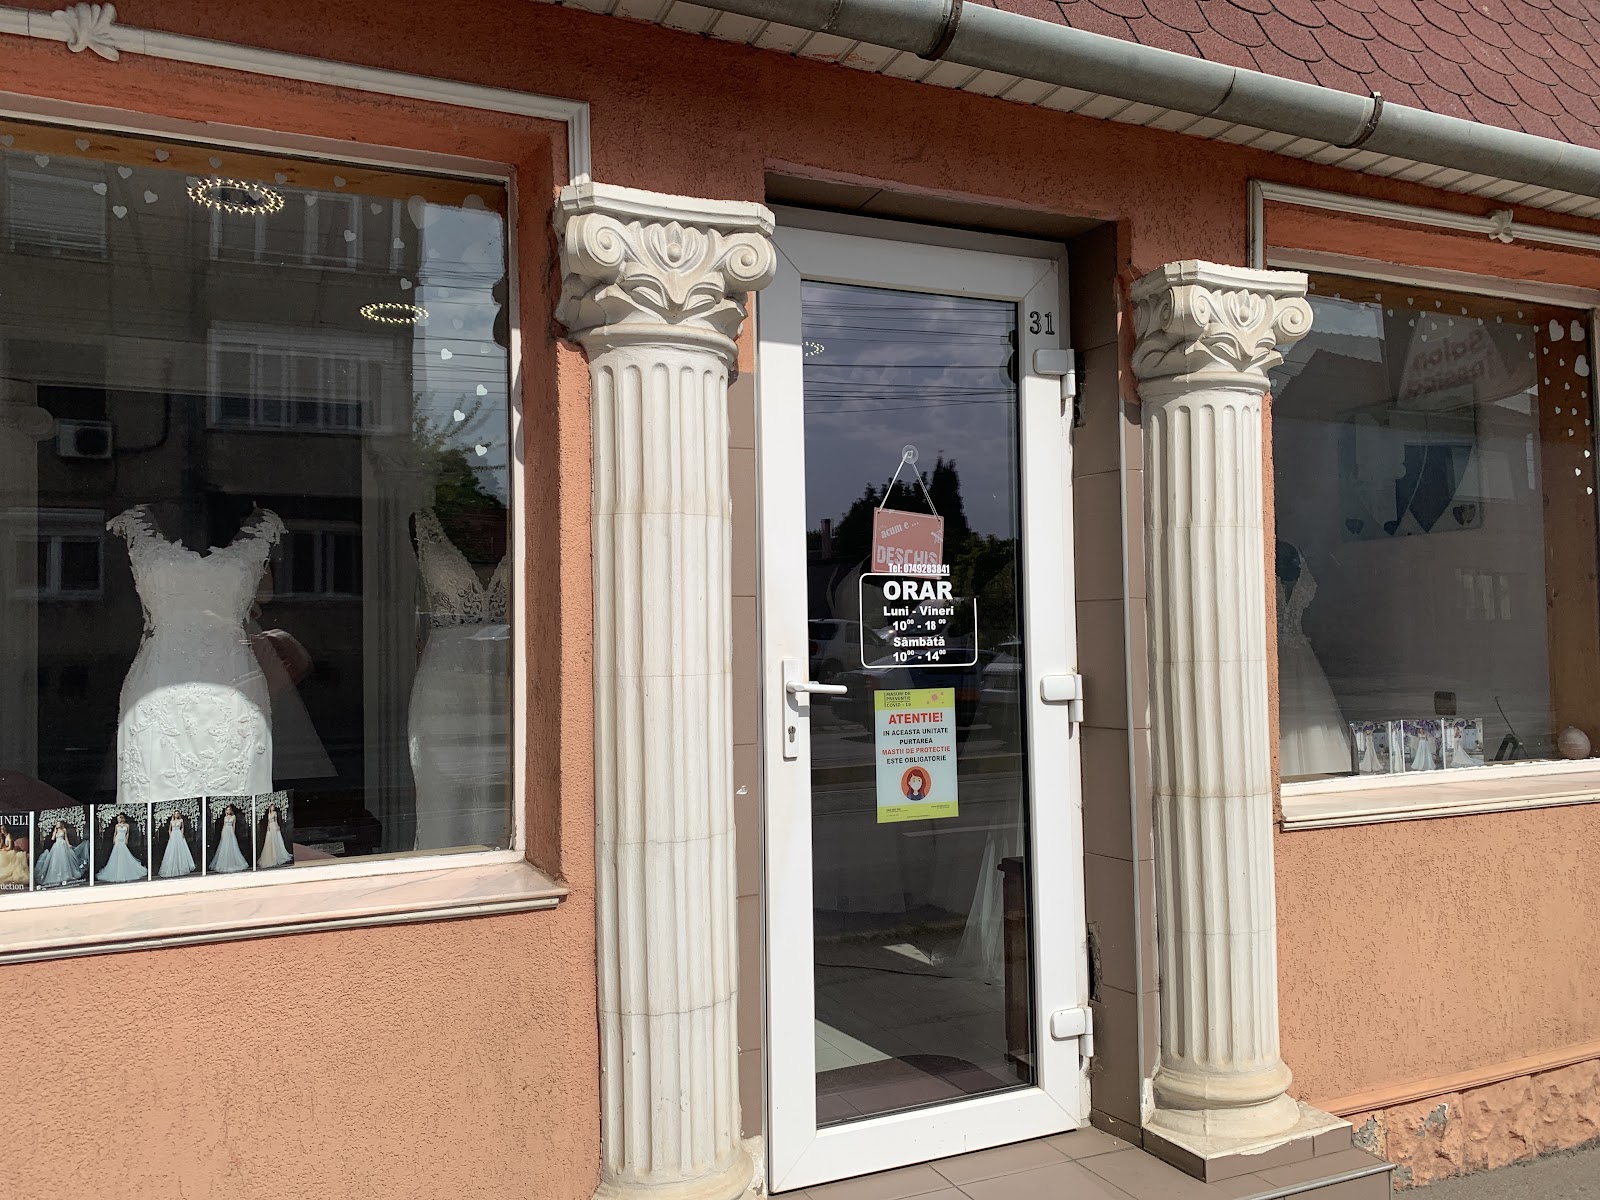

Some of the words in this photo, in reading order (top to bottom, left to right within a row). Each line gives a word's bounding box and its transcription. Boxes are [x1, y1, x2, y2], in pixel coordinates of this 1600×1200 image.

[1029, 311, 1055, 335] 31
[880, 524, 903, 539] acum
[876, 544, 938, 565] DESCHIS
[888, 563, 903, 573] Tel:
[903, 563, 950, 574] 0749283841
[883, 581, 953, 600] ORAR
[883, 605, 909, 616] Luni
[919, 605, 954, 616] Vineri
[893, 636, 946, 647] Sâmbătă
[888, 711, 943, 725] ATENTIE!
[891, 728, 921, 736] ACEASTA
[915, 745, 951, 753] PROTECTIE
[886, 757, 903, 765] ESTE
[904, 754, 947, 763] OBLIGATORIE
